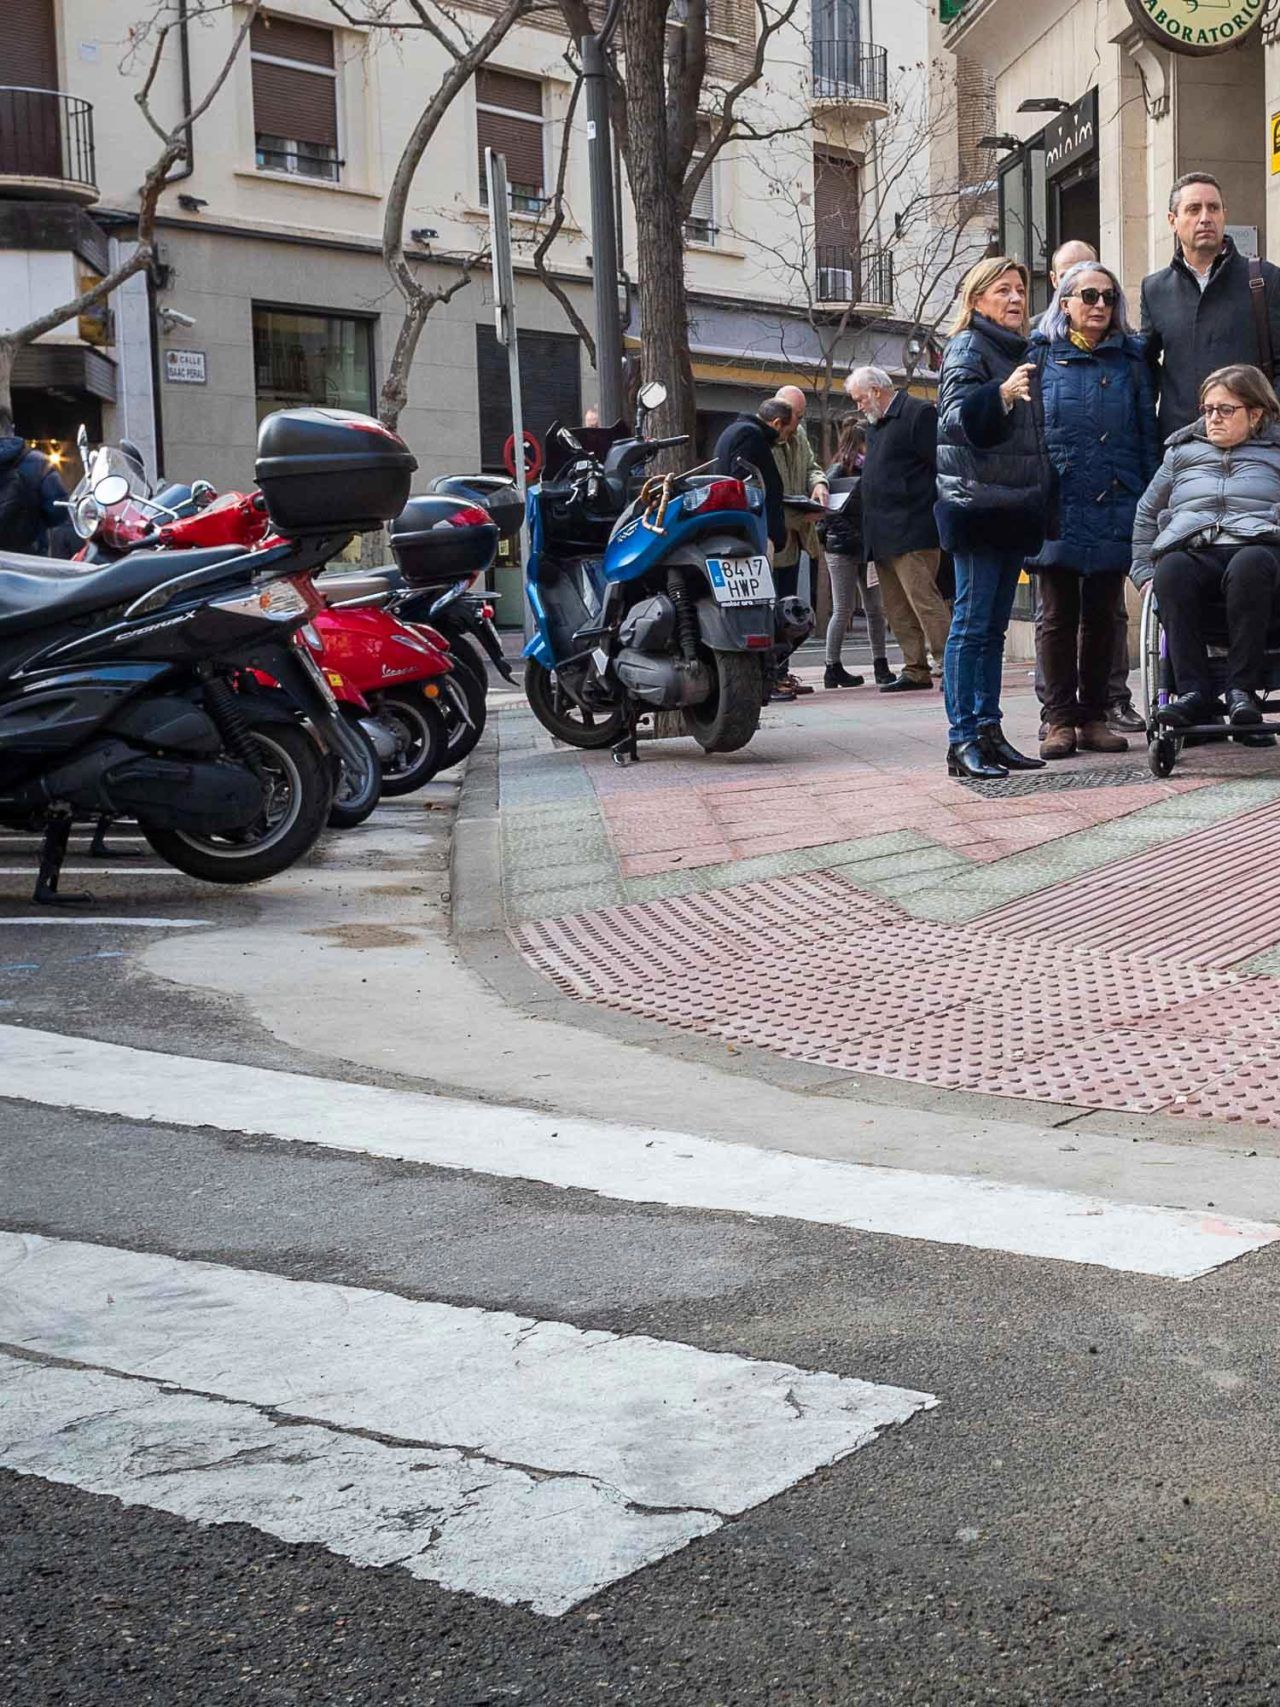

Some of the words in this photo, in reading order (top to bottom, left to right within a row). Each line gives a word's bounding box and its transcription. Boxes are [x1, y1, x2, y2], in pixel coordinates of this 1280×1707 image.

[1144, 0, 1261, 43] ABORATORIO
[180, 355, 200, 365] CALLE
[722, 559, 762, 578] 8417
[727, 579, 760, 598] HWP
